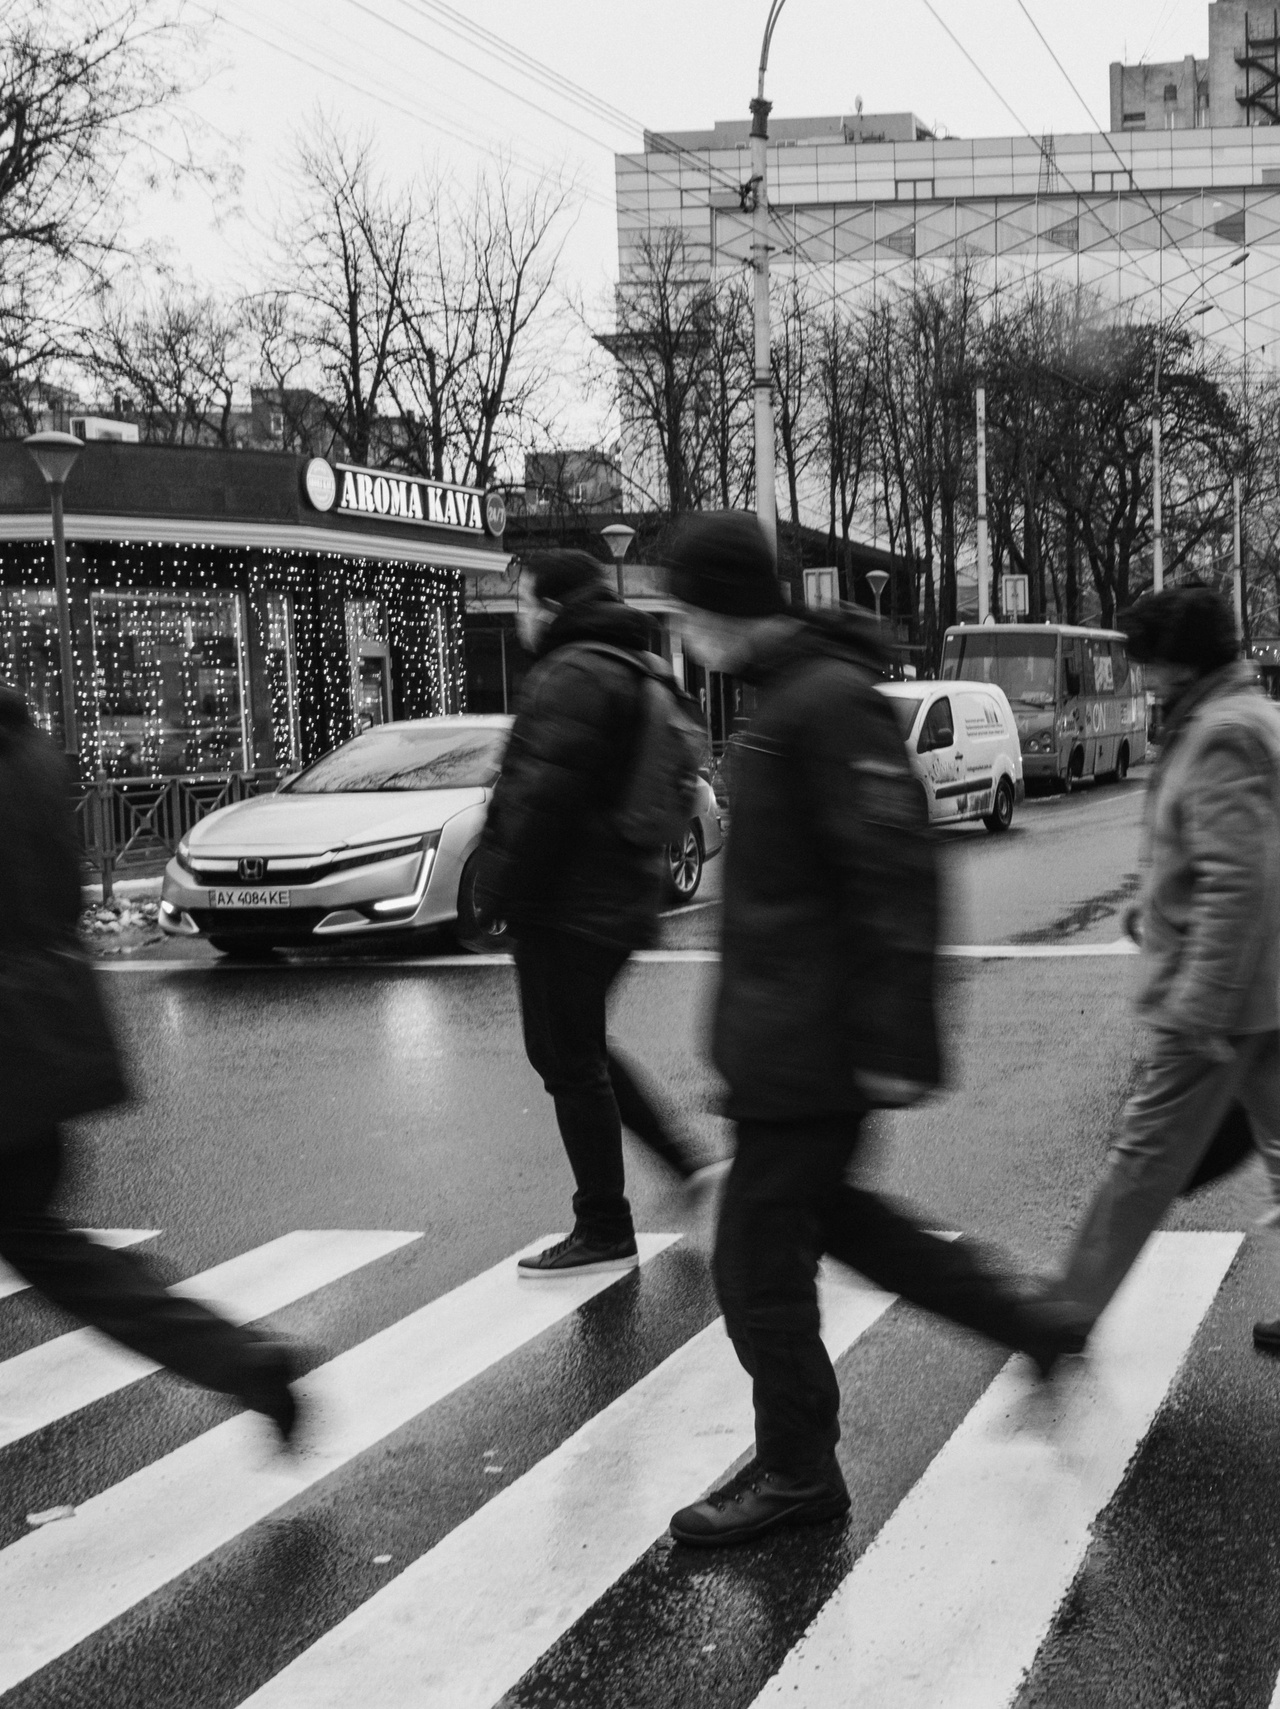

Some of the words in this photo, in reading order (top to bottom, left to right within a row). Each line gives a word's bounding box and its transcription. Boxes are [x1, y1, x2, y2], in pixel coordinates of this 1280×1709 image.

[341, 471, 423, 520] AROMA
[427, 486, 483, 529] KAVA
[489, 506, 506, 524] 24/7
[237, 891, 267, 905] 4084
